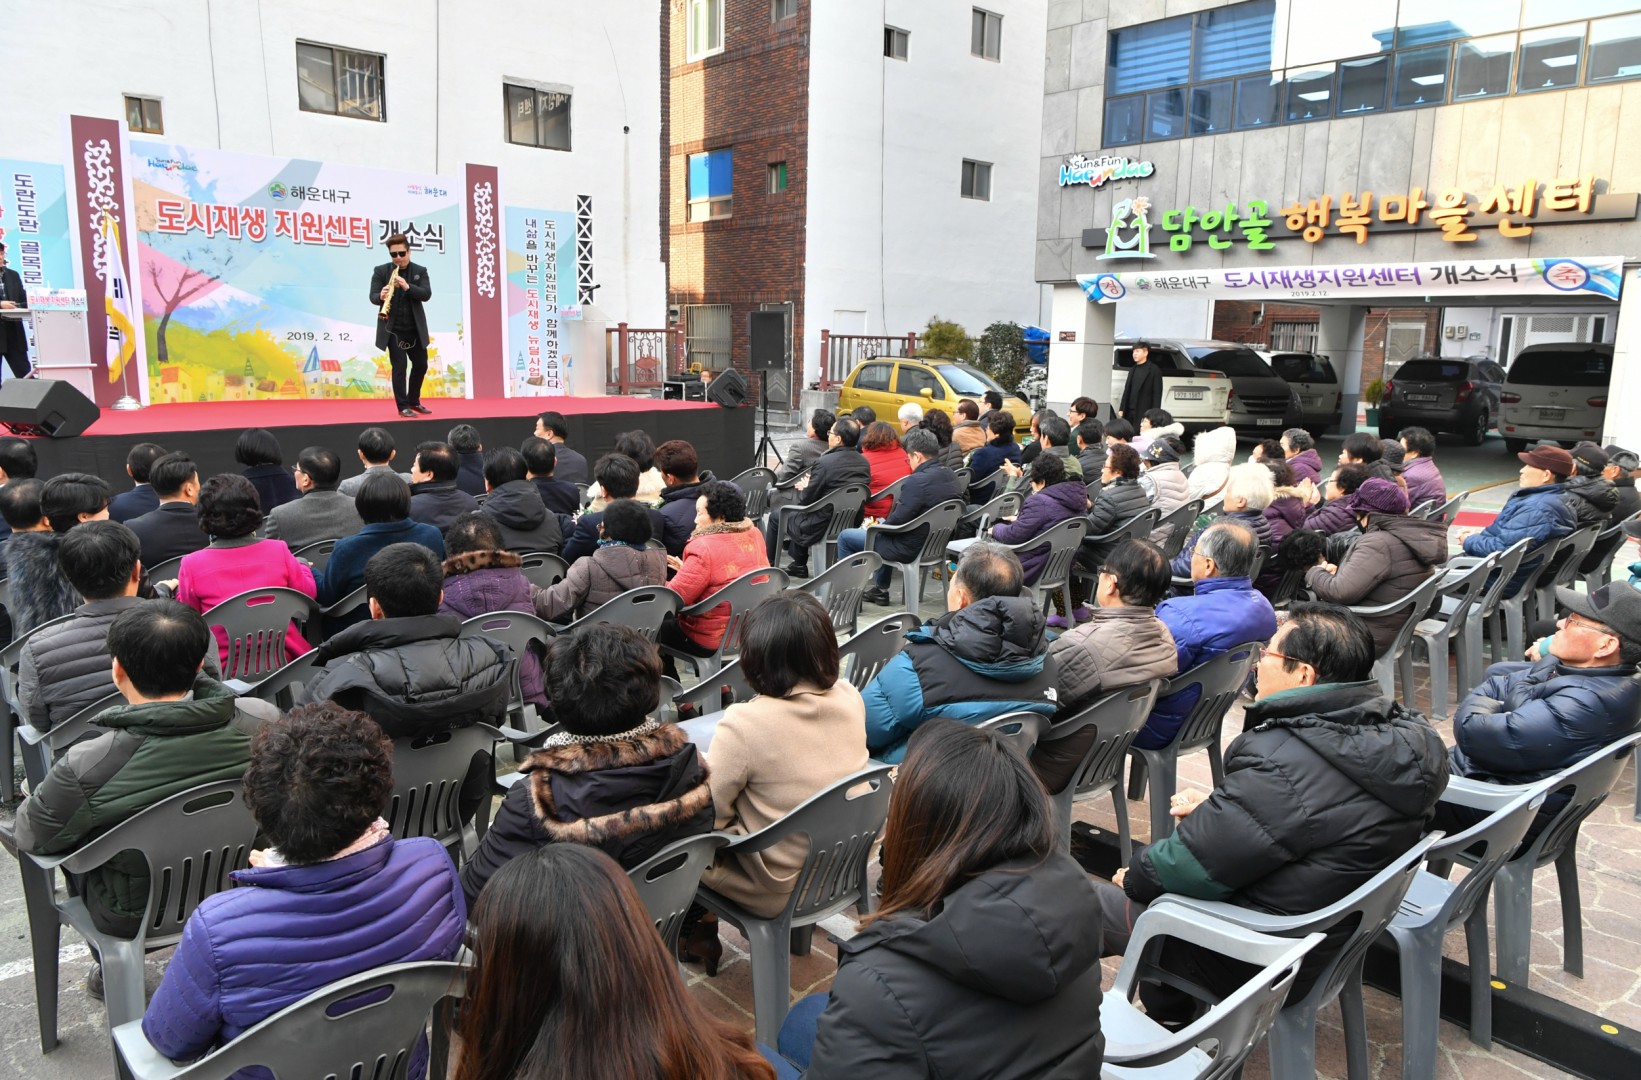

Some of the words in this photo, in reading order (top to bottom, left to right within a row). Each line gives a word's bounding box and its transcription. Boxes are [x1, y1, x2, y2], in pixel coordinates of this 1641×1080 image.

[1060, 158, 1152, 186] Haeundae
[1073, 157, 1121, 170] Sun&Fun
[14, 173, 39, 233] 도란도란
[290, 185, 352, 205] 해운대구
[157, 200, 267, 242] 도시재생
[274, 209, 373, 246] 지원센터
[379, 218, 446, 251] 개소식
[1161, 199, 1277, 253] 담안골
[1279, 173, 1597, 245] 행복마을센터
[526, 254, 538, 284] 바꾸는
[1153, 276, 1211, 290] 해운대구
[1223, 266, 1423, 290] 도시재생지원센터
[1429, 262, 1519, 285] 개소식
[527, 289, 539, 331] 도시재생
[287, 331, 318, 341] 2019.
[323, 332, 333, 342] 2.
[339, 332, 353, 342] 12.
[528, 335, 541, 377] 뉴딜사업
